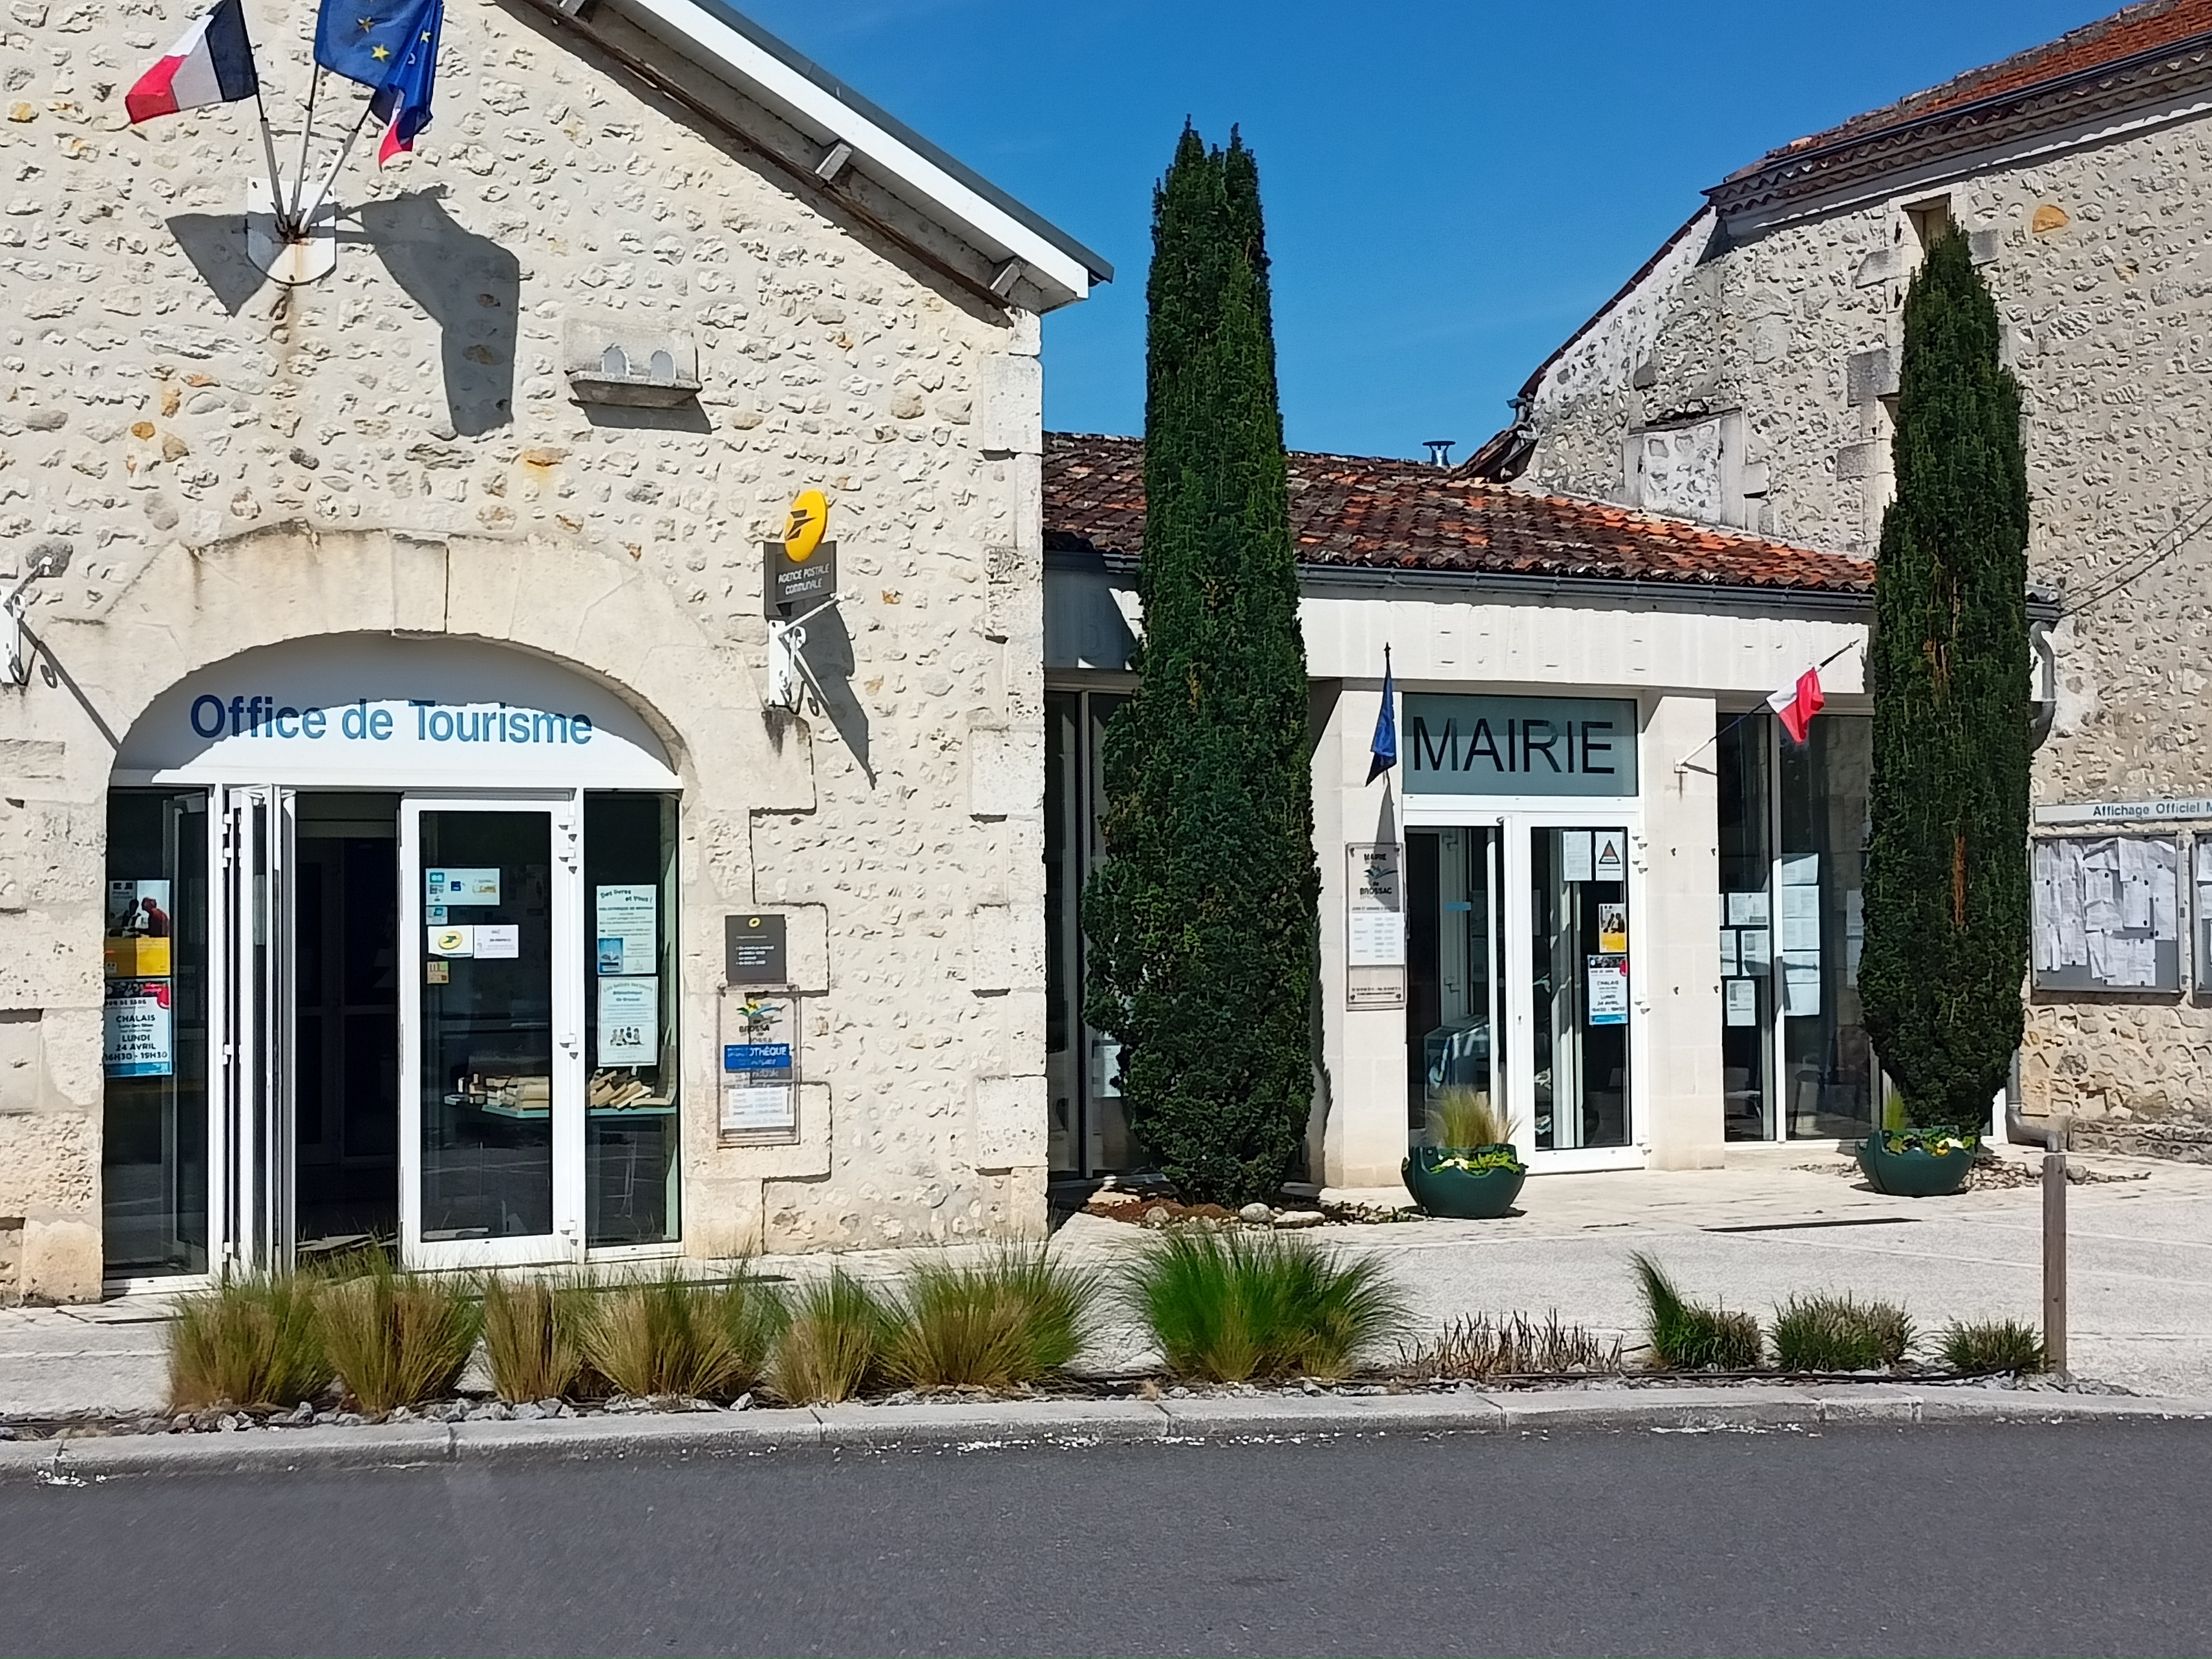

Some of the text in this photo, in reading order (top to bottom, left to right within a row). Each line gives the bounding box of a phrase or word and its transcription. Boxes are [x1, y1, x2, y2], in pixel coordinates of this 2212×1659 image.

[778, 563, 830, 584] AGENCE POSTALE
[785, 577, 822, 595] COMMUNALE
[191, 695, 592, 744] Office de Tourisme
[1413, 717, 1614, 774] MAIRIE
[2093, 805, 2150, 817] Affichage
[2156, 802, 2200, 814] Officiel
[116, 1014, 155, 1023] CHALAIS
